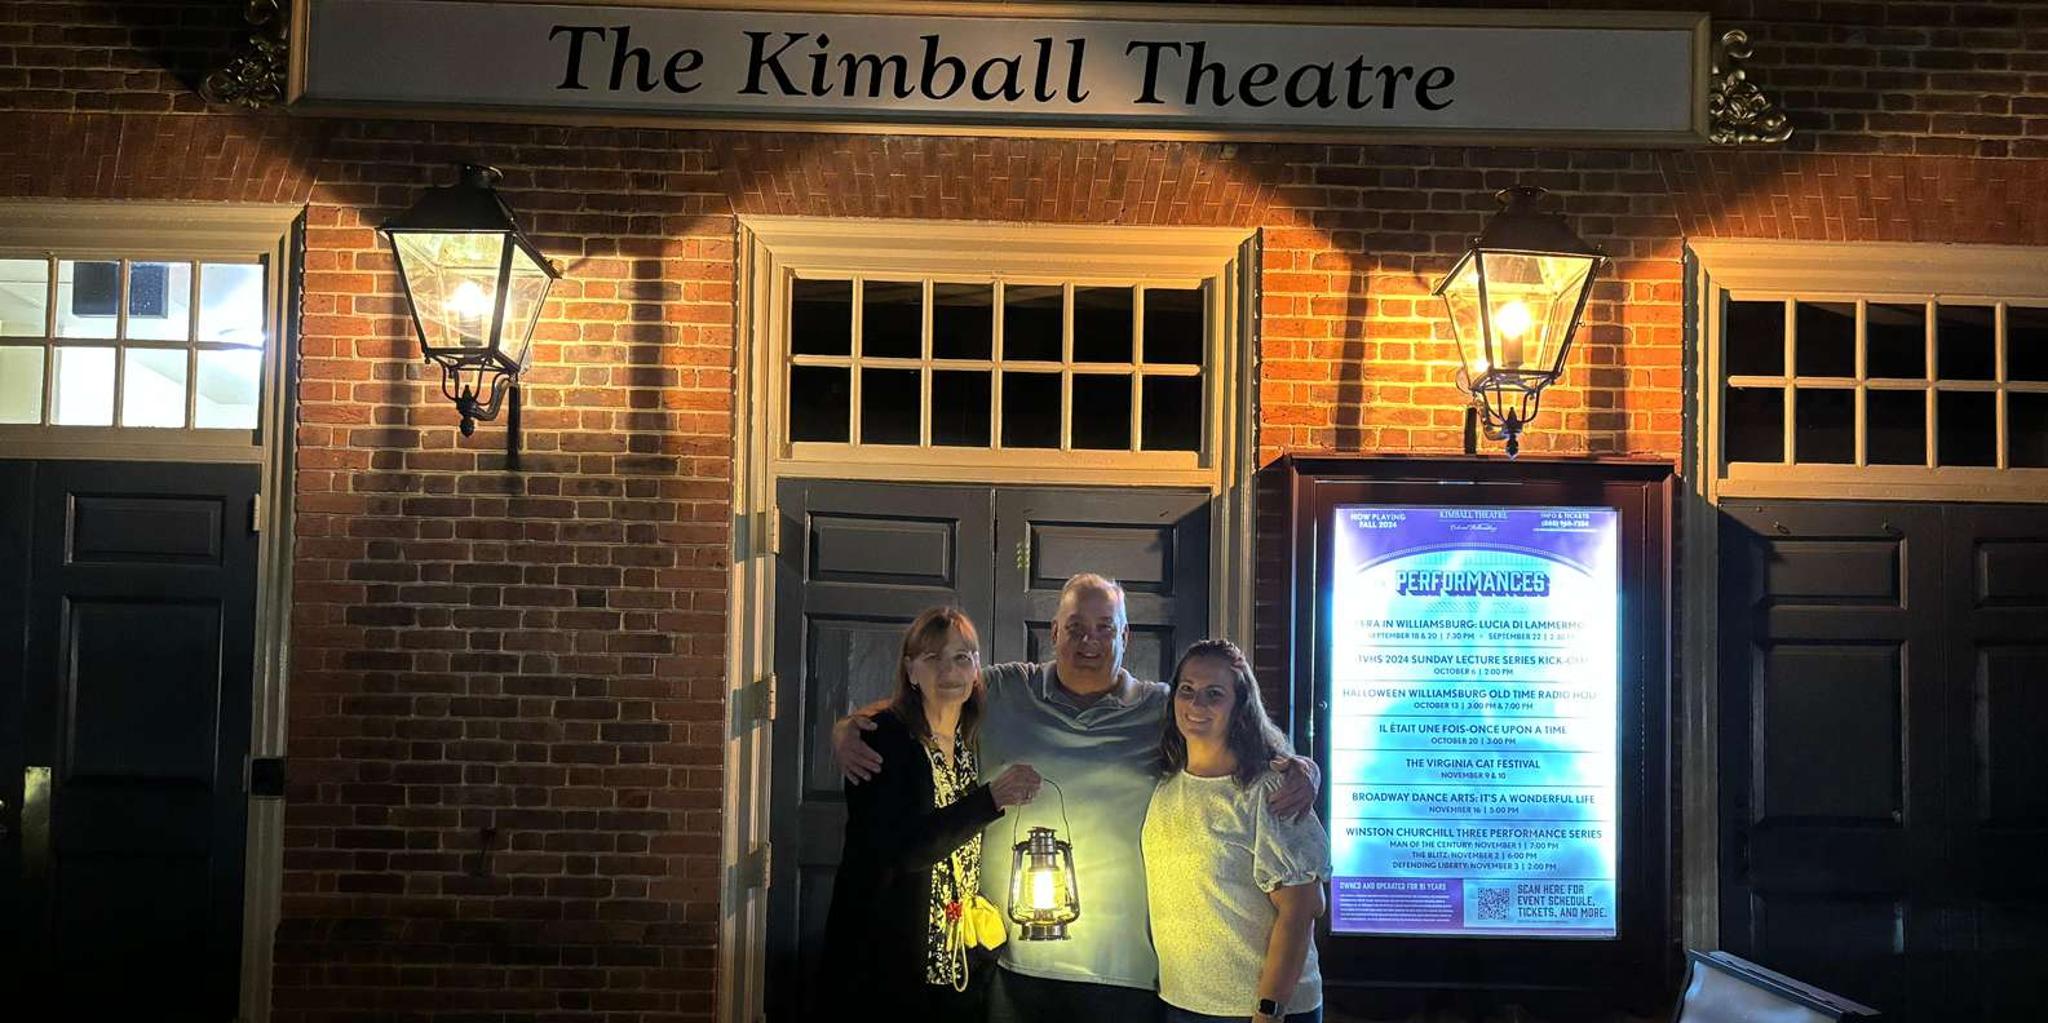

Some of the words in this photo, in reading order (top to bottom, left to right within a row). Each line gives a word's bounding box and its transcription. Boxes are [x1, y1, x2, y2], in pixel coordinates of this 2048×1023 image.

[548, 25, 704, 94] The
[737, 30, 1090, 104] Kimball
[1125, 40, 1456, 111] Theatre
[1372, 513, 1406, 521] PLAYING
[1359, 521, 1377, 529] FALL
[1378, 521, 1398, 529] 2024
[1396, 570, 1550, 597] PERFORMANCES
[1383, 620, 1394, 628] IN
[1396, 619, 1477, 630] WILLIAMSBURG:
[1479, 620, 1510, 630] LUCIA
[1512, 620, 1524, 630] DI
[1428, 632, 1437, 640] 20
[1463, 632, 1475, 640] PM
[1488, 632, 1531, 641] SEPTEMBER
[1532, 633, 1541, 641] 22
[1385, 654, 1409, 664] 2024
[1411, 655, 1454, 665] SUNDAY
[1456, 655, 1500, 665] LECTURE
[1502, 656, 1536, 665] SERIES
[1433, 667, 1470, 676] OCTOBER
[1502, 669, 1514, 677] PM
[1343, 688, 1406, 698] HALLOWEEN
[1408, 688, 1487, 699] WILLIAMSBURG
[1488, 689, 1511, 699] OLD
[1512, 690, 1537, 700] TIME
[1538, 690, 1571, 701] RADIO
[1572, 691, 1598, 701] HOU
[1414, 702, 1449, 710] OCTOBER
[1485, 702, 1497, 711] PM
[1522, 703, 1534, 711] PM
[1379, 724, 1388, 734] IL
[1390, 721, 1416, 734] ÉTAIT
[1418, 724, 1441, 735] UNE
[1442, 724, 1500, 735] FOIS-ONCE
[1501, 725, 1533, 735] UPON
[1534, 725, 1543, 735] A
[1544, 726, 1567, 736] TIME
[1431, 737, 1468, 745] OCTOBER
[1469, 737, 1479, 745] 20
[1504, 738, 1517, 746] PM
[1406, 758, 1425, 768] THE
[1427, 759, 1474, 769] VIRGINIA
[1475, 759, 1495, 769] CAT
[1497, 759, 1541, 770] FESTIVAL
[1441, 771, 1484, 780] NOVEMBER
[1352, 792, 1410, 803] BROADWAY
[1412, 793, 1448, 803] DANCE
[1450, 794, 1479, 804] ARTS:
[1480, 793, 1498, 804] IT'S
[1500, 794, 1508, 804] A
[1509, 794, 1575, 805] WONDERFUL
[1576, 795, 1596, 805] LIFE
[1429, 806, 1472, 815] NOVEMBER
[1507, 807, 1520, 815] PM
[1346, 827, 1394, 837] WINSTON
[1396, 827, 1455, 838] CHURCHILL
[1457, 828, 1489, 838] THREE
[1490, 828, 1568, 839] PERFORMANCE
[1569, 829, 1603, 840] SERIES
[1390, 841, 1409, 849] MAN
[1410, 841, 1421, 849] OF
[1422, 841, 1436, 849] THE
[1474, 842, 1517, 850] NOVEMBER
[1530, 842, 1547, 850] 7:00
[1412, 852, 1427, 860] THE
[1451, 852, 1493, 861] NOVEMBER
[1525, 853, 1538, 861] PM
[1392, 862, 1437, 870] DEFENDING
[1470, 863, 1513, 871] NOVEMBER
[1527, 863, 1544, 871] 2:00
[1407, 883, 1418, 891] FOR
[1428, 883, 1447, 891] YEARS
[1517, 884, 1542, 895] SCAN
[1543, 885, 1567, 895] HERE
[1568, 885, 1585, 895] FOR
[1517, 895, 1546, 906] EVENT
[1548, 895, 1596, 907] SCHEDULE,
[1517, 907, 1558, 919] TICKETS,
[1560, 908, 1578, 918] AND
[1580, 908, 1608, 919] MORE.
